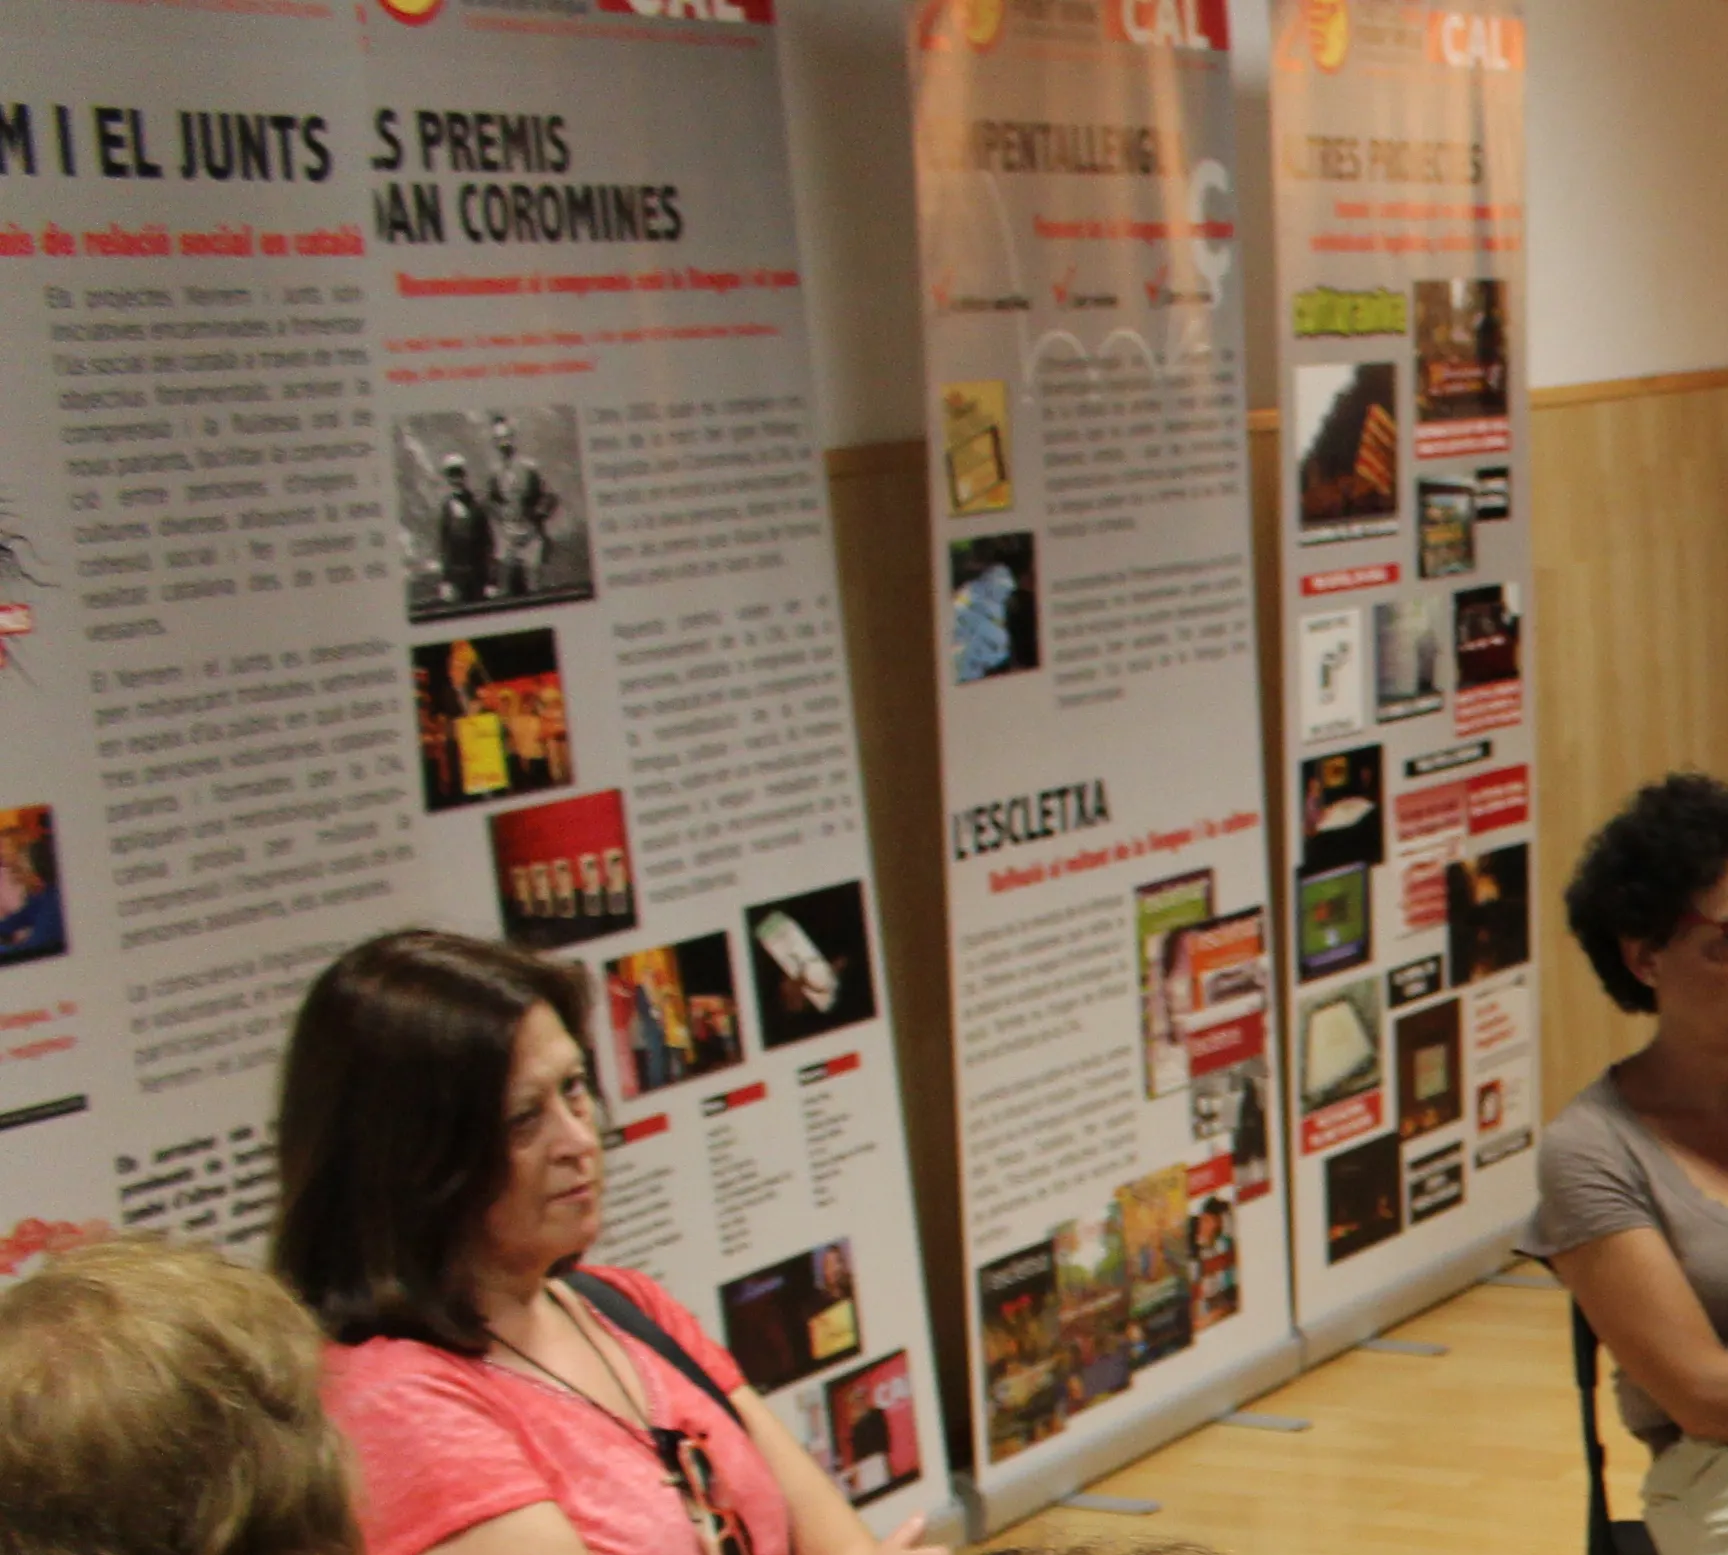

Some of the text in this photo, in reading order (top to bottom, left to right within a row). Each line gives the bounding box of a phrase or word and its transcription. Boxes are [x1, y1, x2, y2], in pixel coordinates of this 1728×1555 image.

[1121, 0, 1212, 49] CAL
[1440, 14, 1511, 71] CAL
[95, 107, 163, 179] EL
[178, 111, 333, 183] JUNTS
[414, 109, 571, 174] PREMIS
[458, 182, 685, 246] COROMINES
[952, 778, 1111, 862] L'ESCLETXA
